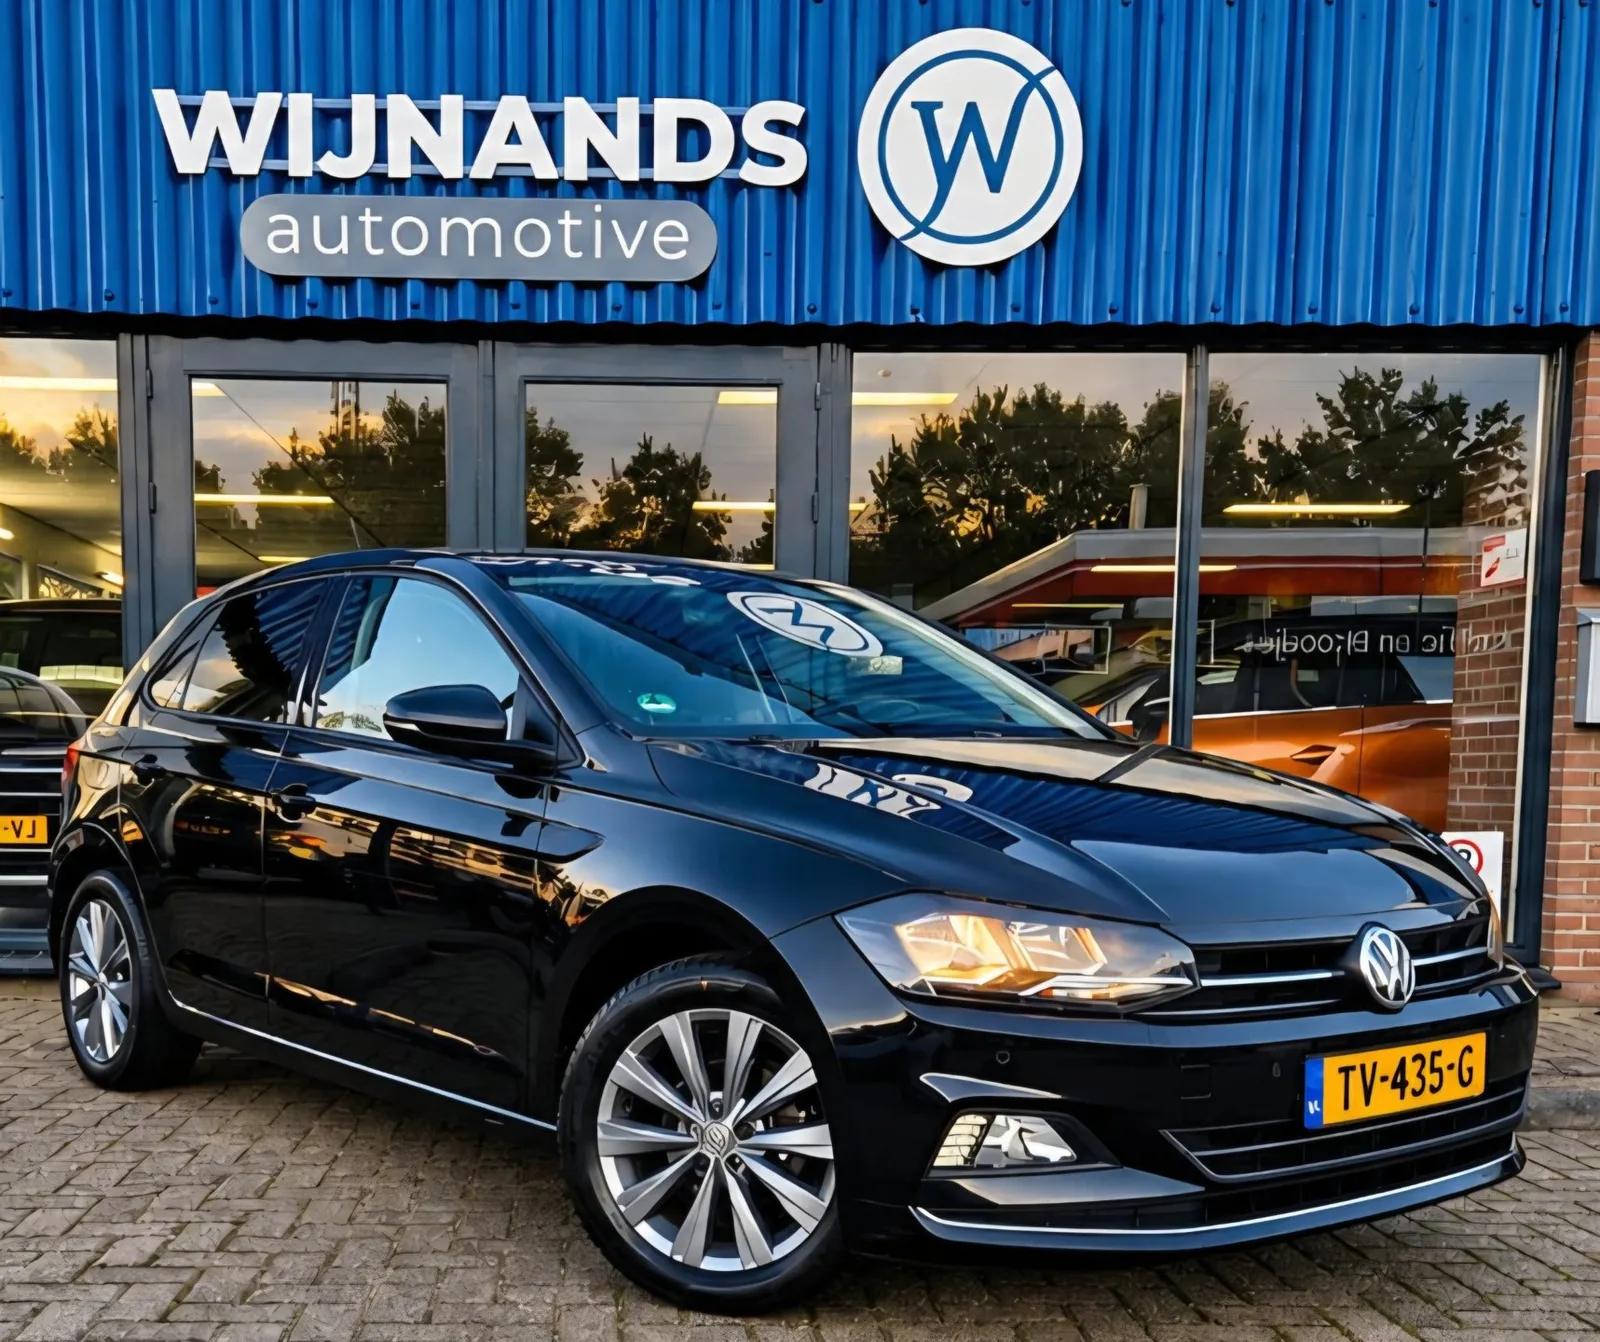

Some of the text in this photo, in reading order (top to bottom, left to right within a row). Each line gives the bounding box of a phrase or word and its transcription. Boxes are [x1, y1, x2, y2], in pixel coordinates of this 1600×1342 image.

[152, 89, 807, 186] WIJNANDS
[266, 204, 689, 260] automotive
[1338, 1045, 1473, 1111] TV-435-G
